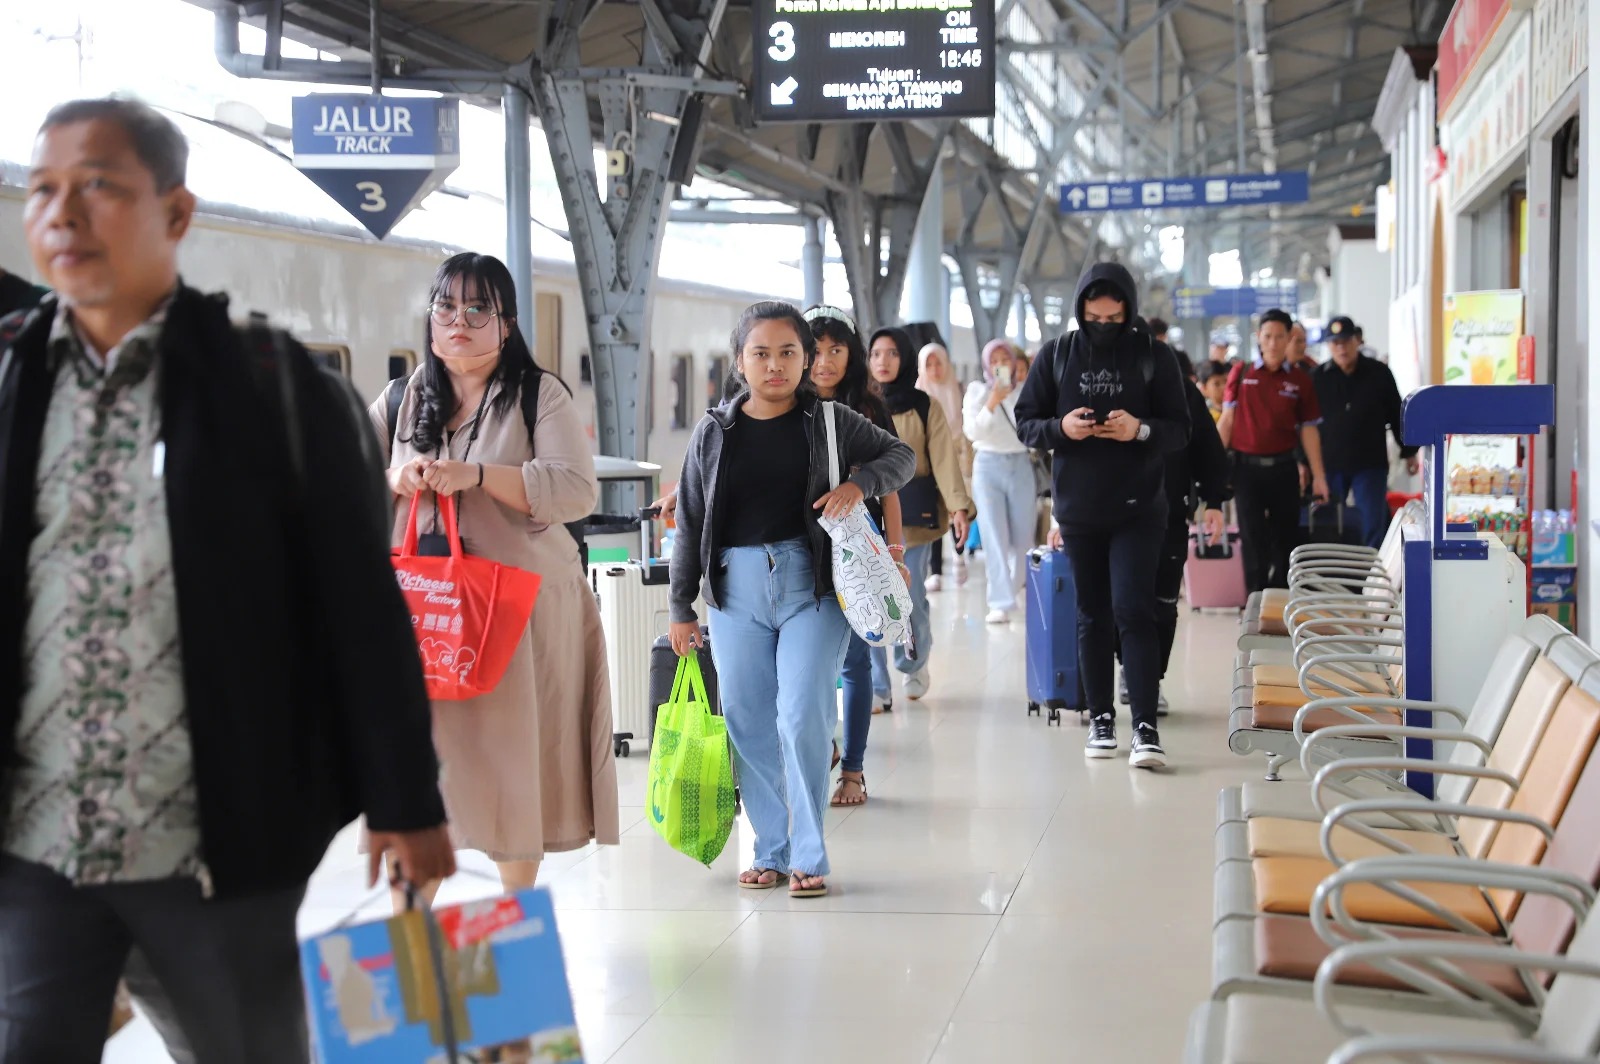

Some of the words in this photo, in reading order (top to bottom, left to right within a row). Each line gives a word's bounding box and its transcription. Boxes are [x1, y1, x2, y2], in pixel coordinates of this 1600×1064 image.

[946, 11, 971, 26] ON
[768, 21, 796, 62] 3
[829, 30, 905, 48] MENOREH
[939, 27, 978, 44] TIME
[867, 67, 914, 84] Tujuan
[822, 81, 900, 98] SEMARANG
[901, 80, 963, 96] TAWANG
[846, 95, 885, 111] BANK
[887, 94, 943, 110] JATENG
[313, 105, 413, 133] JALUR
[334, 135, 392, 154] TRACK
[355, 181, 387, 213] 3
[394, 569, 455, 592] Richeese
[424, 591, 462, 610] Factory
